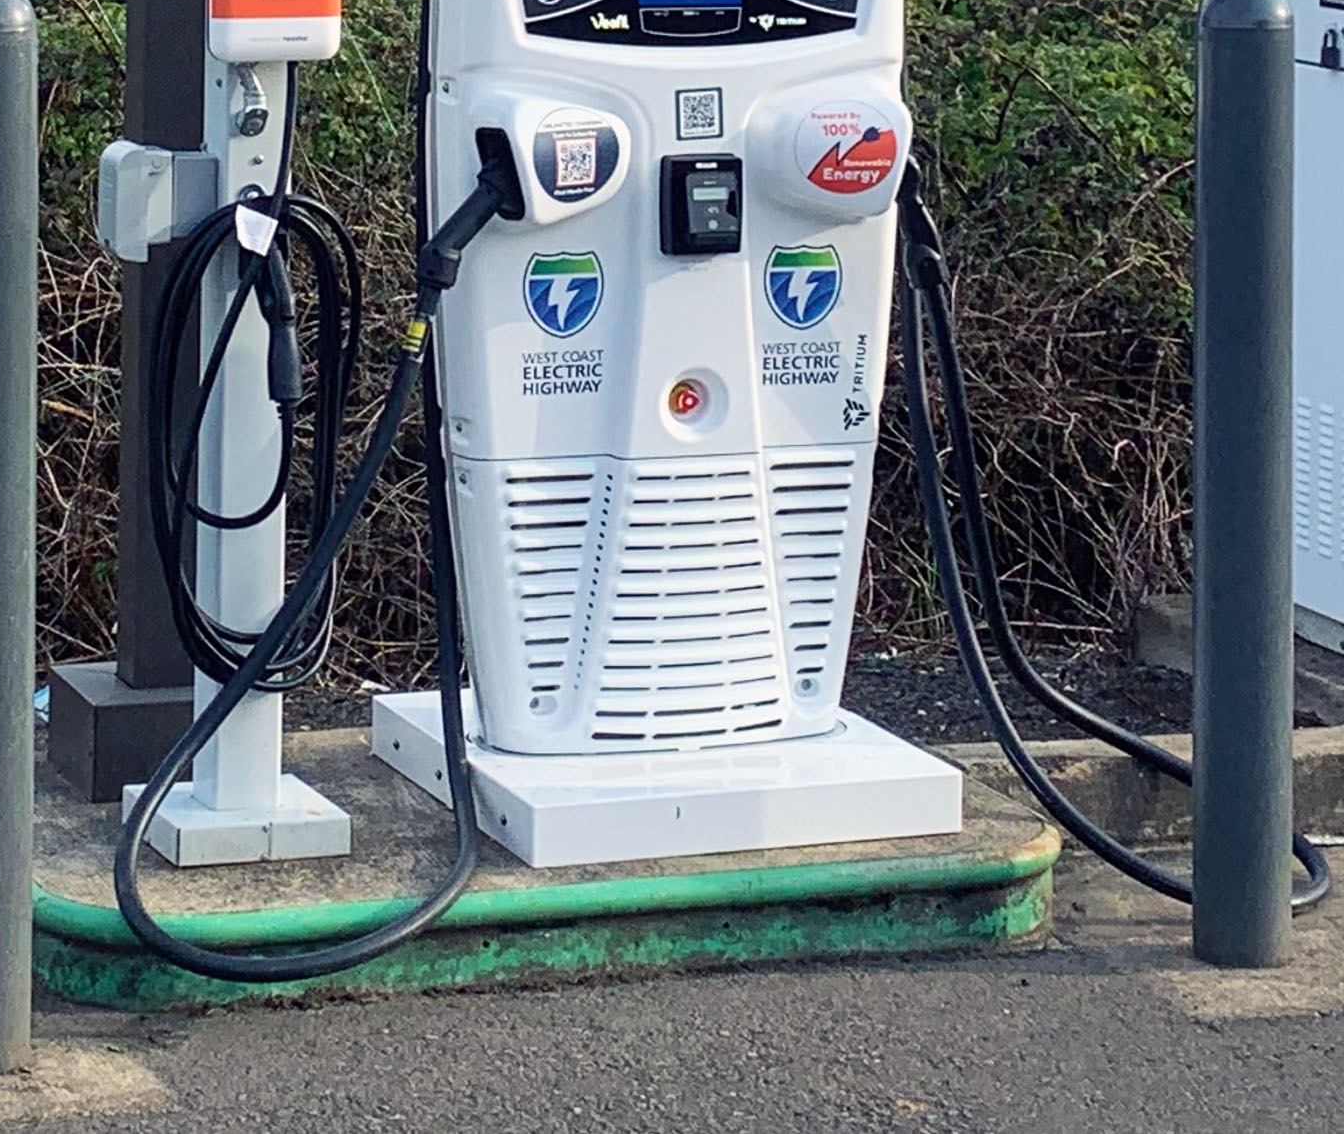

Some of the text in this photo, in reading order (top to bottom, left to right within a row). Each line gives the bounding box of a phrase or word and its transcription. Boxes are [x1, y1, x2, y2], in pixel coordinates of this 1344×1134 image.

[822, 124, 862, 136] 100%
[823, 167, 880, 184] Energy
[762, 341, 841, 355] WEST COAST
[522, 349, 604, 363] WEST COAST
[762, 355, 840, 370] ELECTRIC
[853, 333, 868, 393] TRITIUM
[522, 362, 603, 379] ELECTRIC
[762, 370, 839, 385] HIGHWAY
[522, 379, 602, 396] HIGHWAY
